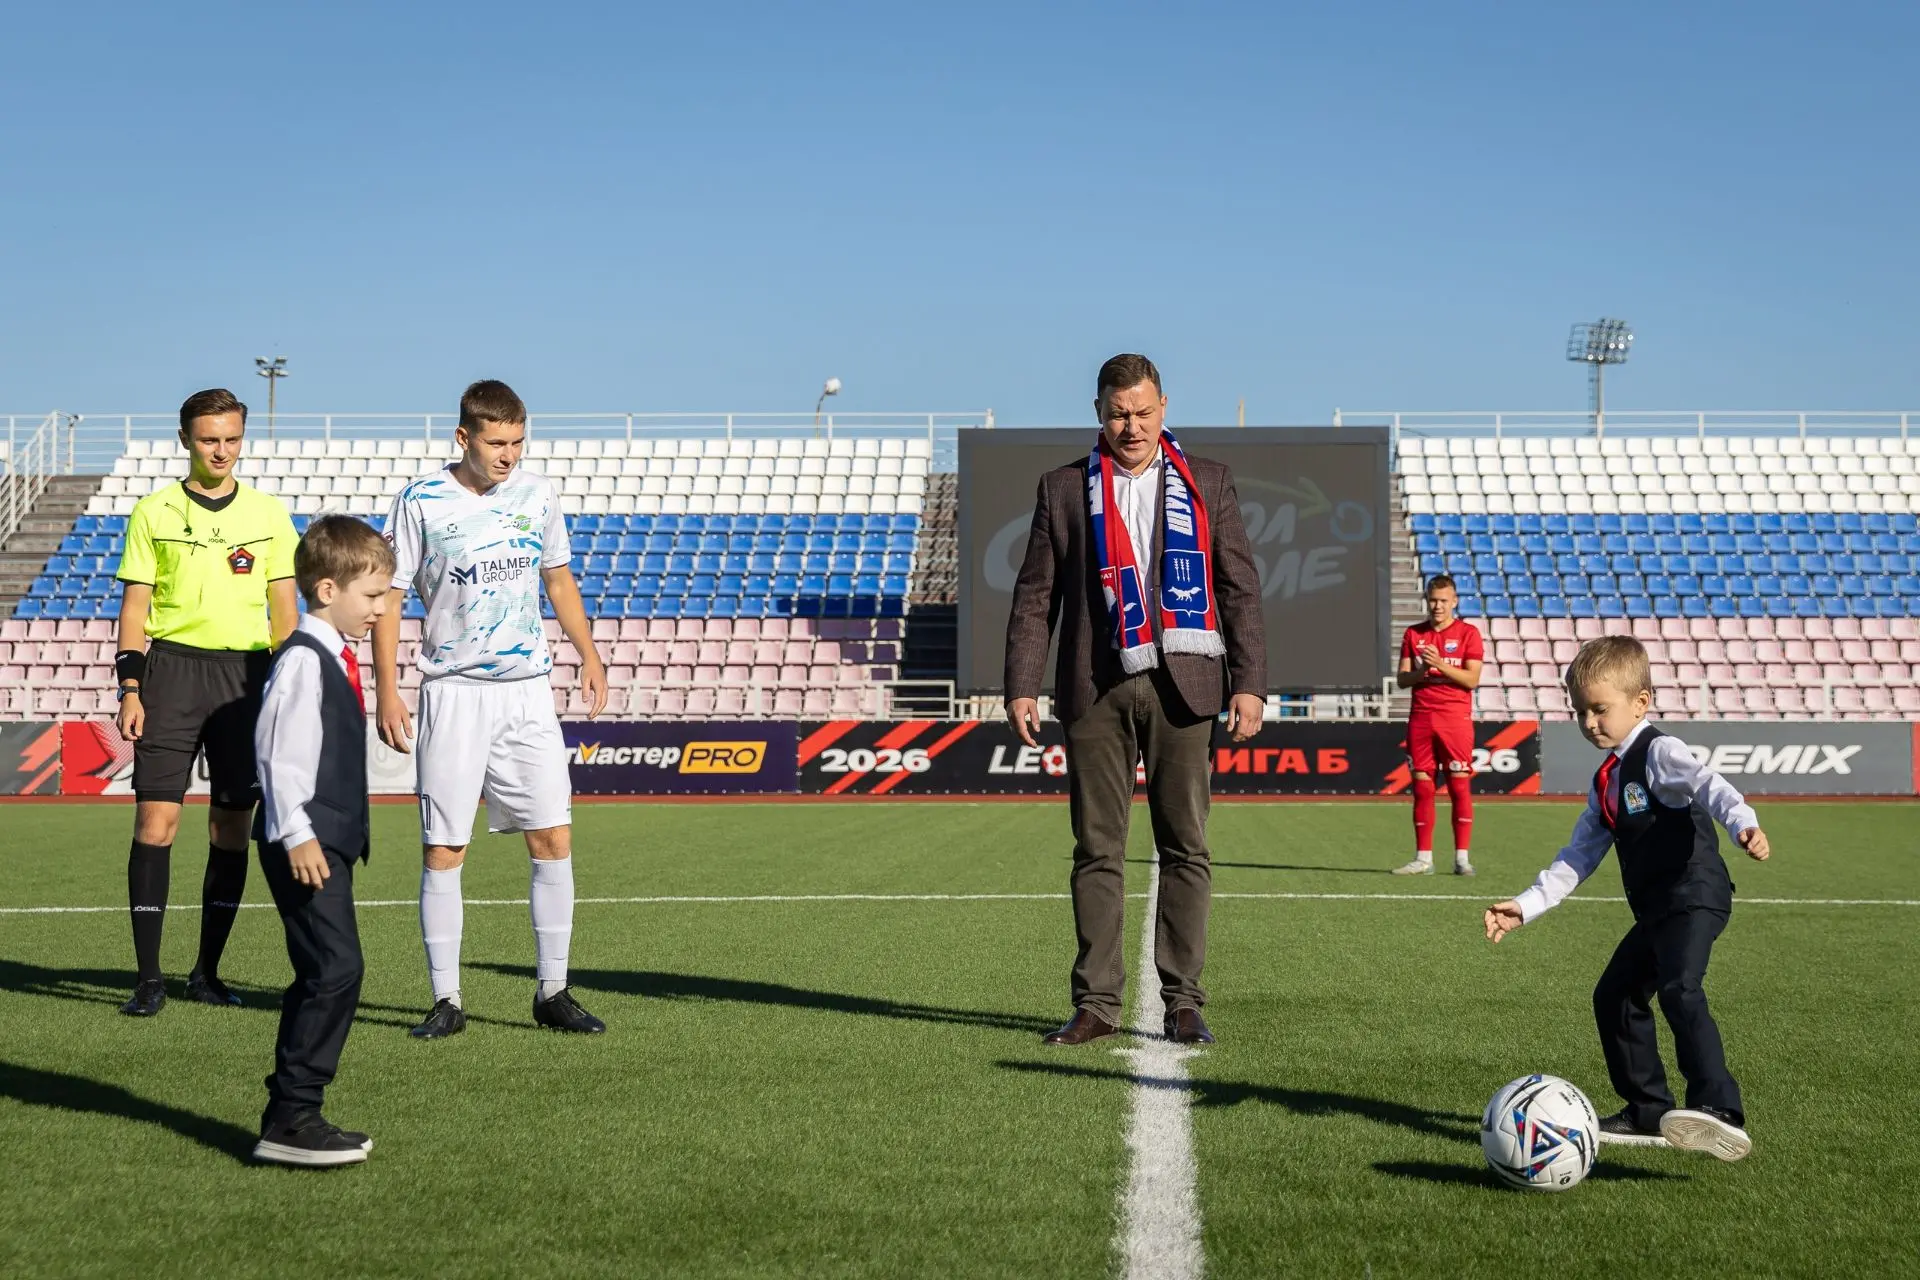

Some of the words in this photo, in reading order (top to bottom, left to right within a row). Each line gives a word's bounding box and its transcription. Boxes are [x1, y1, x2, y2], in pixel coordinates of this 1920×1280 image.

[236, 557, 248, 567] 2
[480, 557, 530, 572] TALMER
[482, 569, 523, 584] GROUP
[687, 748, 757, 767] PRO
[820, 748, 932, 773] 2026
[1209, 748, 1310, 774] ИГА
[1317, 748, 1349, 774] Б
[1471, 748, 1521, 773] 26
